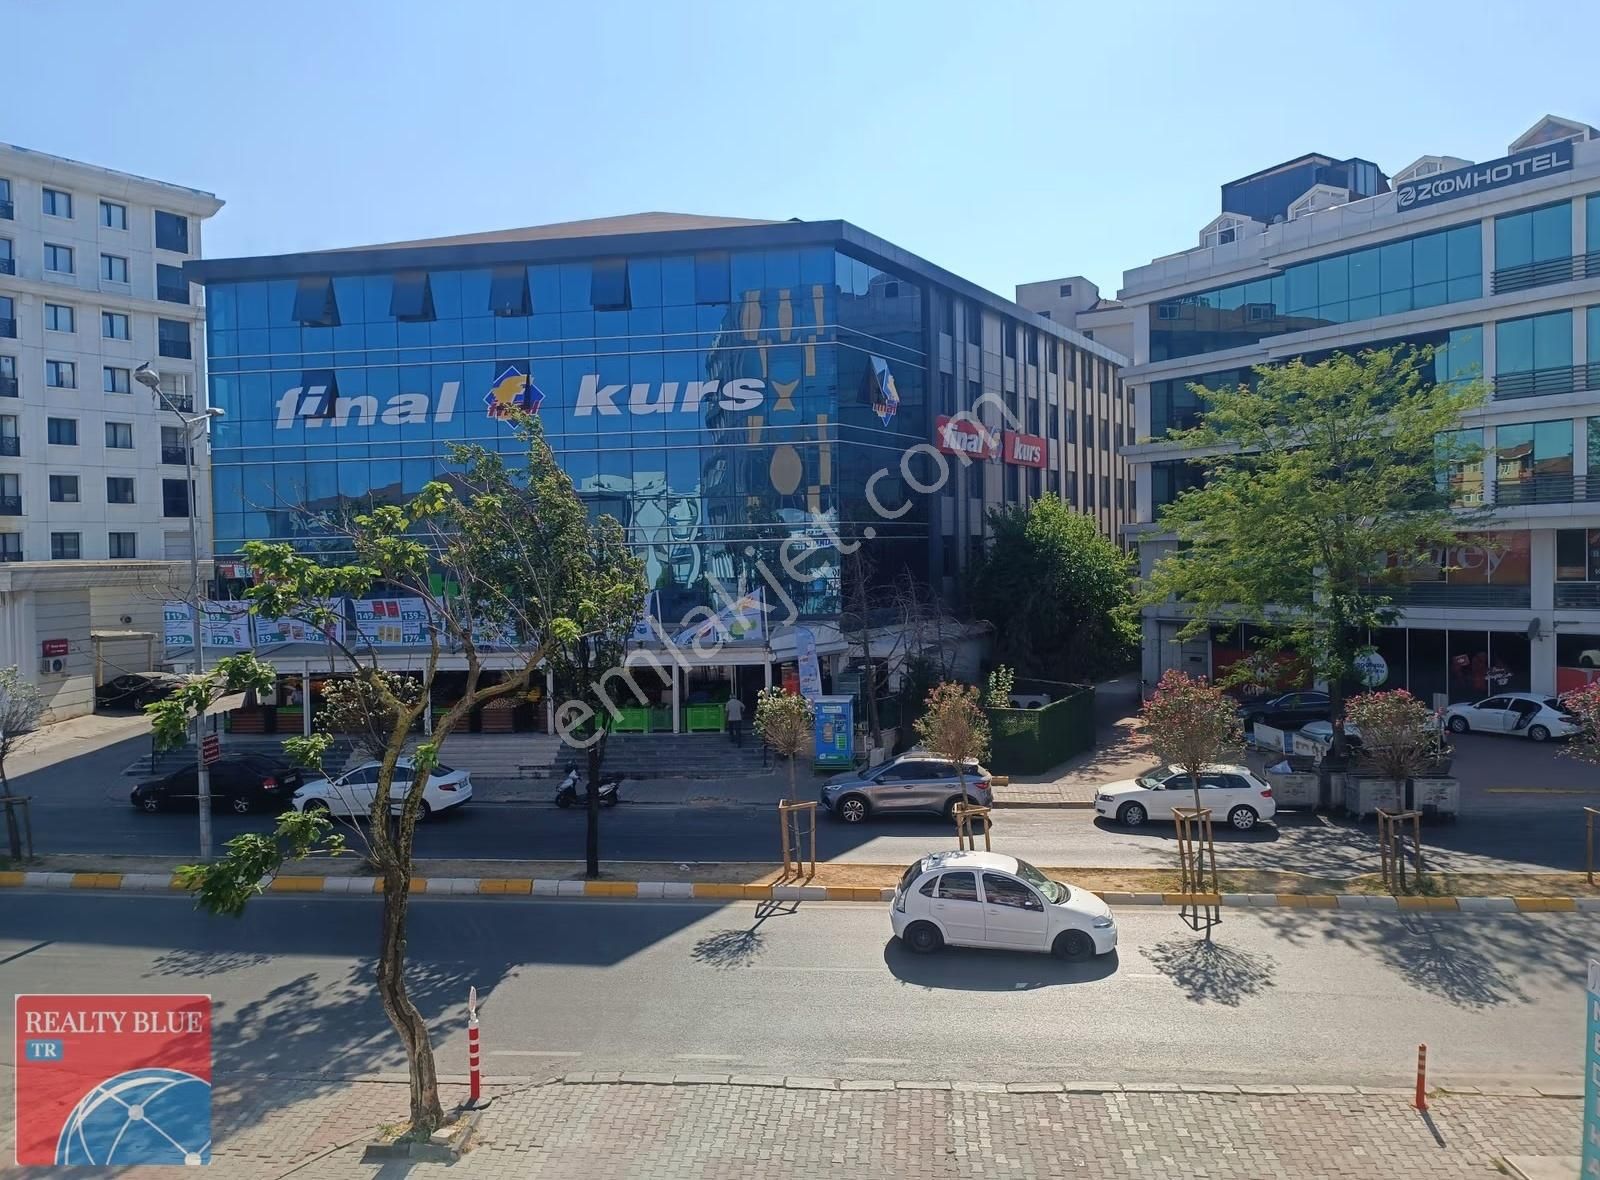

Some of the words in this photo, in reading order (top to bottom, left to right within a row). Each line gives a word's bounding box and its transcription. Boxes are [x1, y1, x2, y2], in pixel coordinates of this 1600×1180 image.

[275, 381, 460, 429] final
[573, 374, 766, 416] kurs
[943, 422, 985, 453] final
[1013, 436, 1041, 462] kurs
